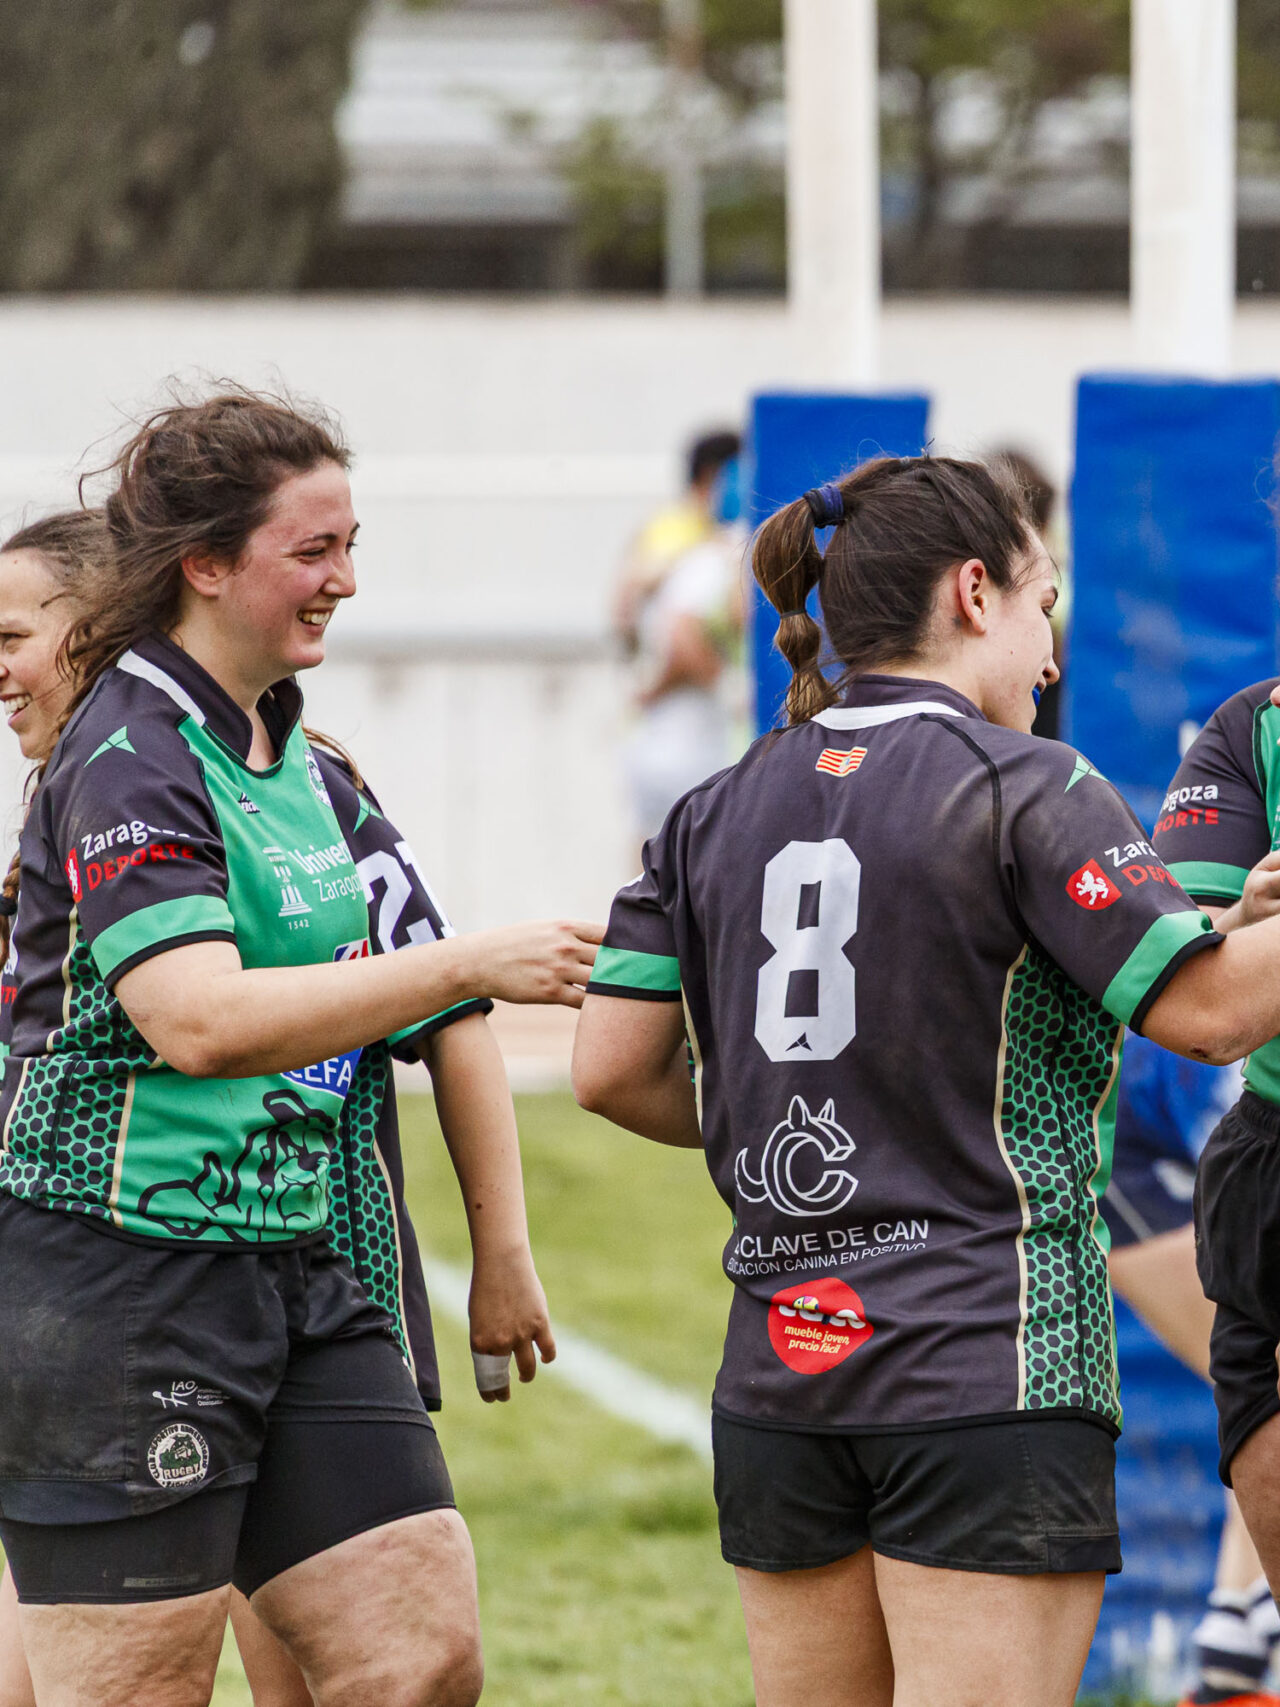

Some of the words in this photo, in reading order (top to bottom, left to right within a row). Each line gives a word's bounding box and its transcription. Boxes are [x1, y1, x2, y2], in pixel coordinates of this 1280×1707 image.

[81, 820, 191, 861] Zarag
[86, 844, 196, 891] DEPORTE
[288, 919, 310, 930] 1542
[754, 837, 862, 1063] 8
[740, 1232, 821, 1259] CLAVE
[826, 1226, 867, 1250] DE
[873, 1219, 929, 1244] CAN
[783, 1253, 838, 1272] CANINA
[840, 1250, 860, 1265] EN
[784, 1325, 823, 1341] mueble
[787, 1339, 821, 1352] precio
[819, 1342, 842, 1354] fácil
[162, 1463, 201, 1480] RUGBY
